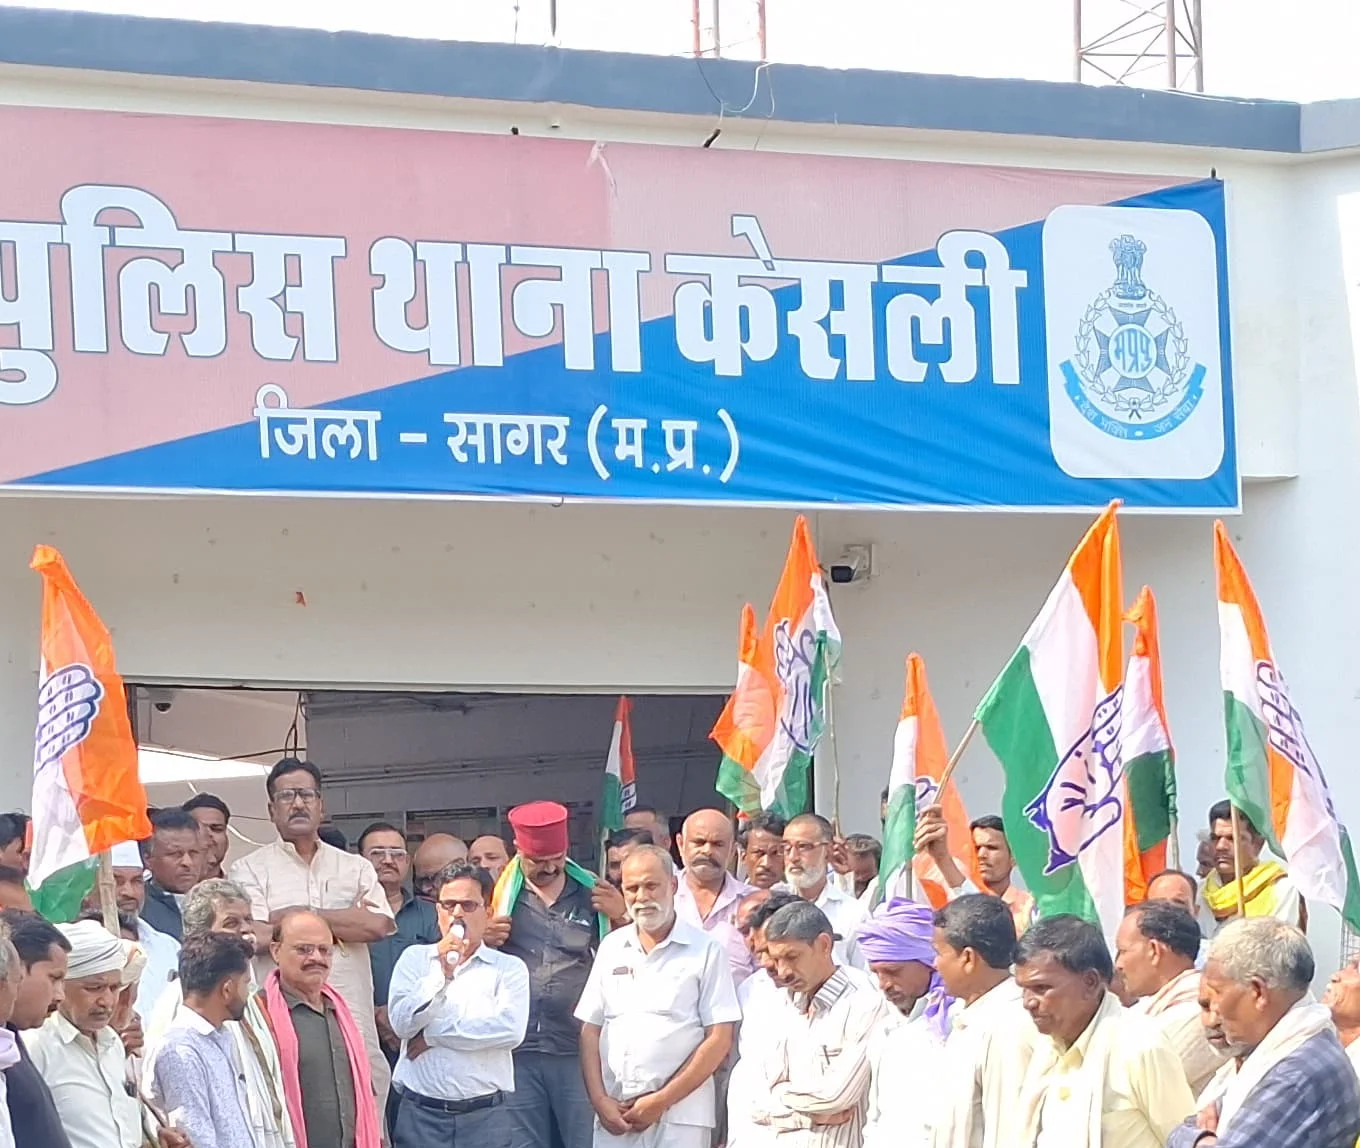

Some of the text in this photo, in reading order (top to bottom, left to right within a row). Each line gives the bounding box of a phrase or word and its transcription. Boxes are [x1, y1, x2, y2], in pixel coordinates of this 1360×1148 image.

[369, 236, 651, 373] थाना
[664, 214, 1028, 385] केसली
[253, 383, 382, 461] जिला
[443, 412, 570, 465] सागर
[587, 403, 739, 483] (म.प्र.)
